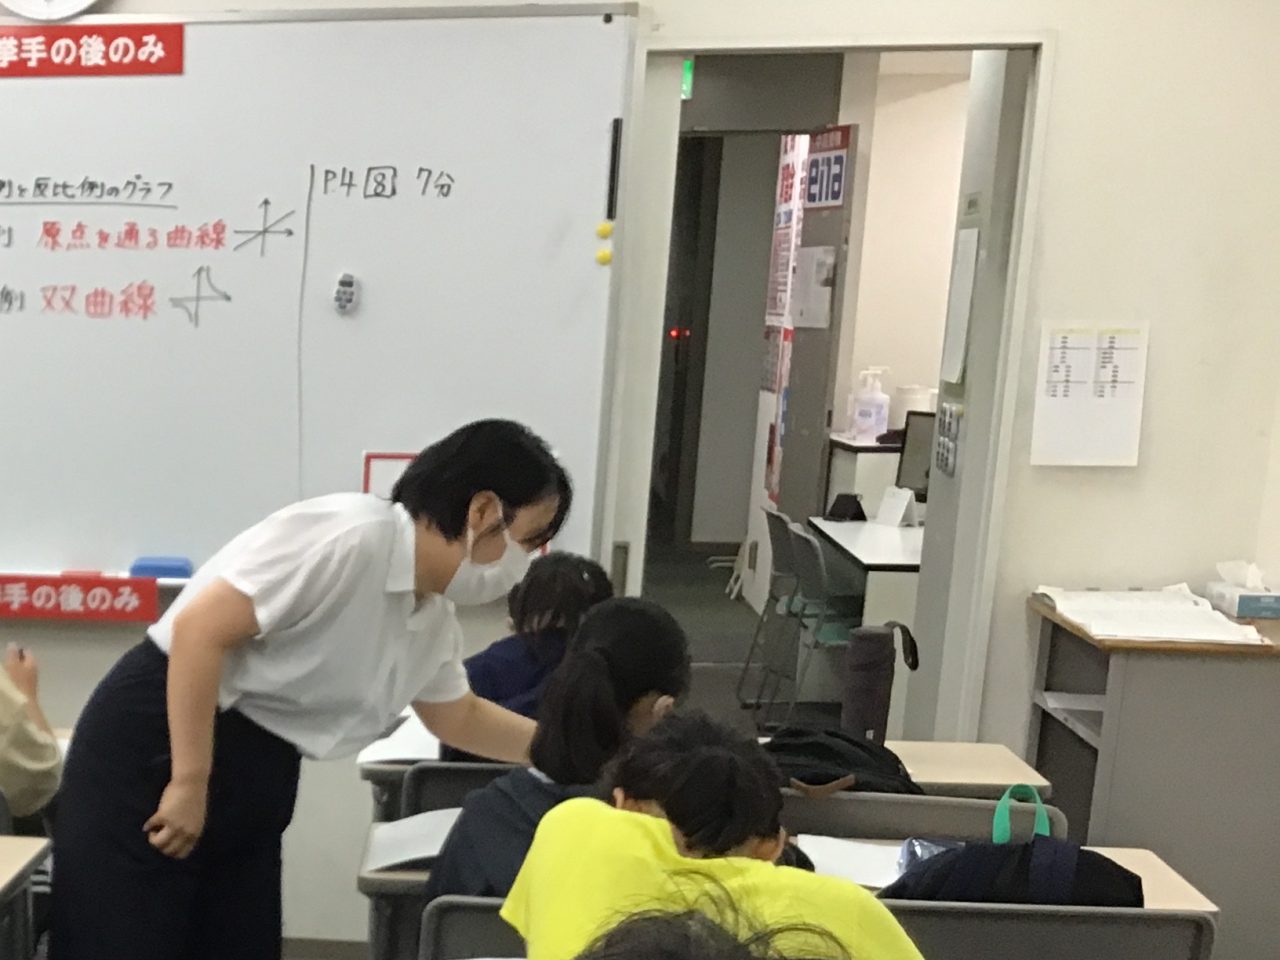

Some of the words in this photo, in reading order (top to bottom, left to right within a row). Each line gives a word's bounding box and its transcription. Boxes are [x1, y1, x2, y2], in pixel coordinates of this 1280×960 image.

[415, 166, 456, 199] 7分
[807, 154, 845, 203] ena
[39, 218, 227, 252] 原点を通る曲線
[41, 279, 156, 321] 双曲線
